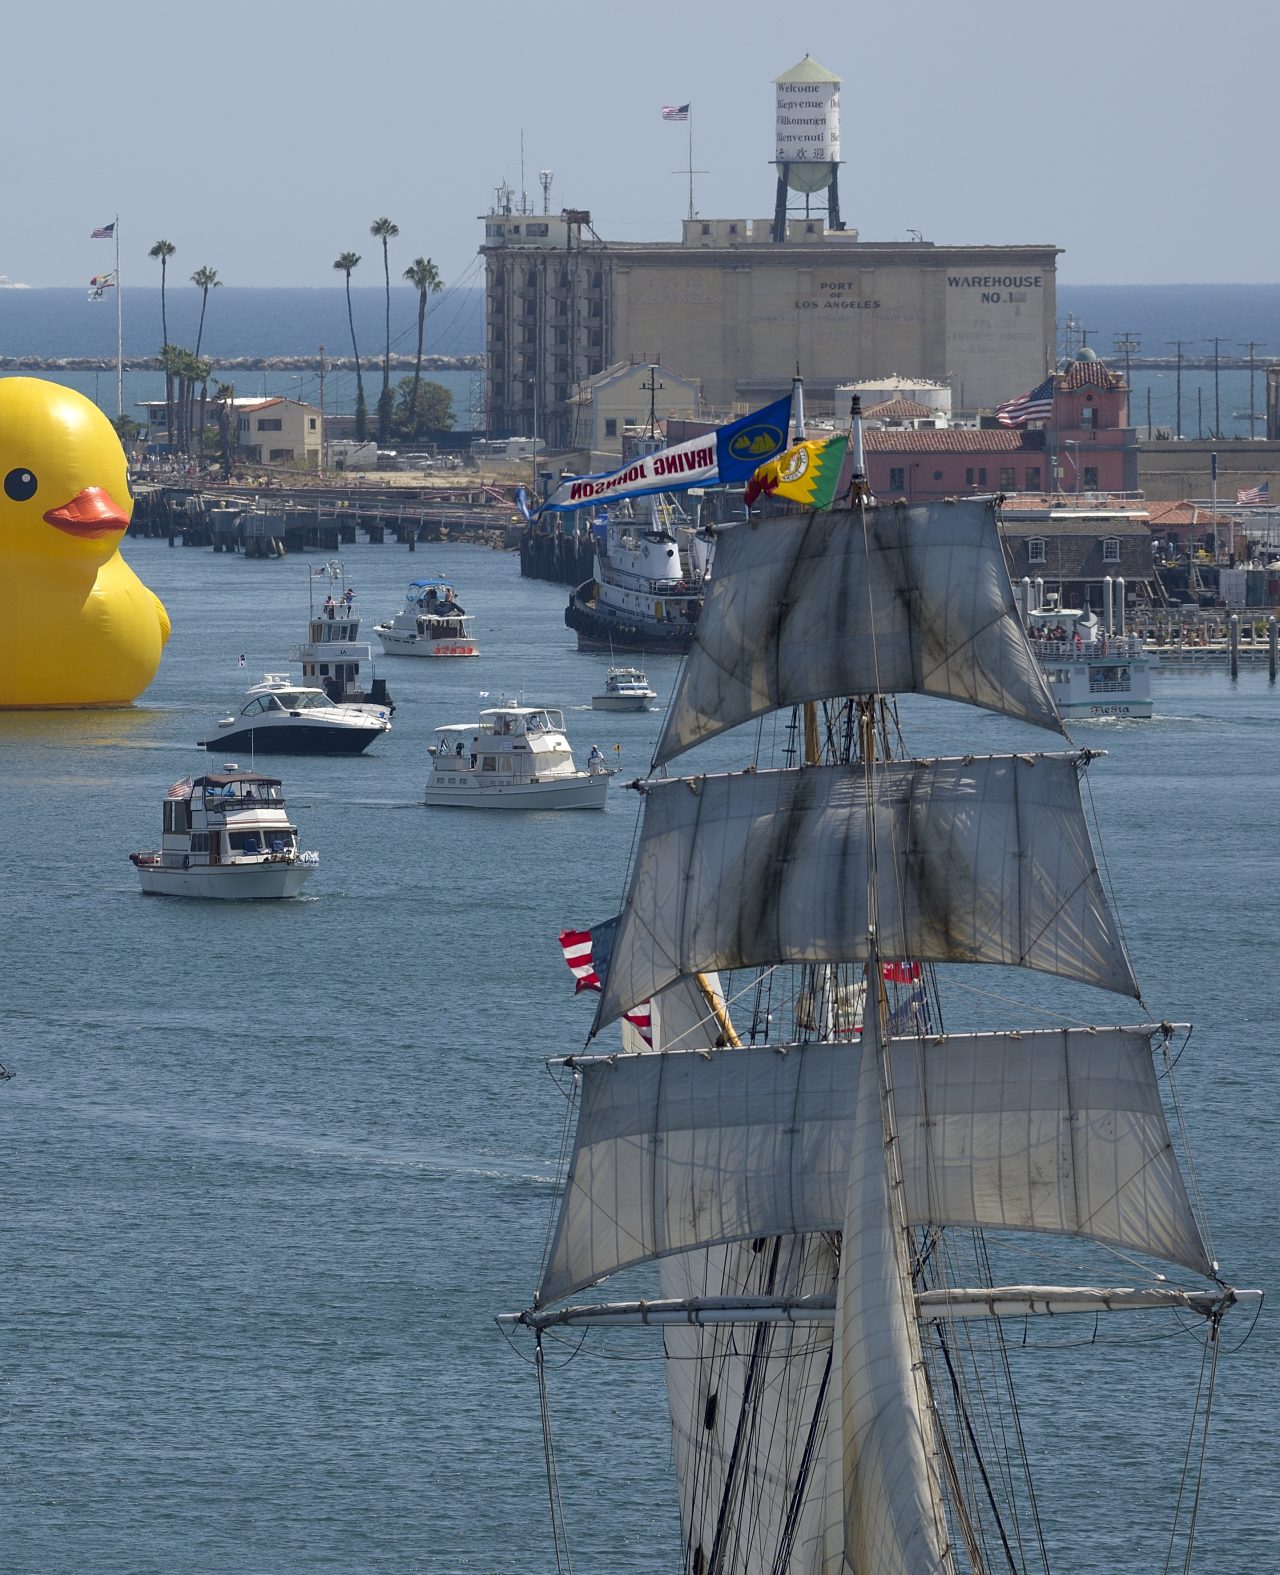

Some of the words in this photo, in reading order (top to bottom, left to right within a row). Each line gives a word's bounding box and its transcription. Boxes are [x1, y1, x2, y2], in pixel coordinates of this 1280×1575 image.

[778, 83, 820, 93] Welcome
[777, 99, 824, 109] Bienvenue
[820, 282, 853, 291] PORT
[947, 276, 1043, 288] WAREHOUSE
[795, 301, 819, 309] LOS
[823, 301, 881, 309] ANGELES
[1090, 705, 1130, 714] Fiesta
